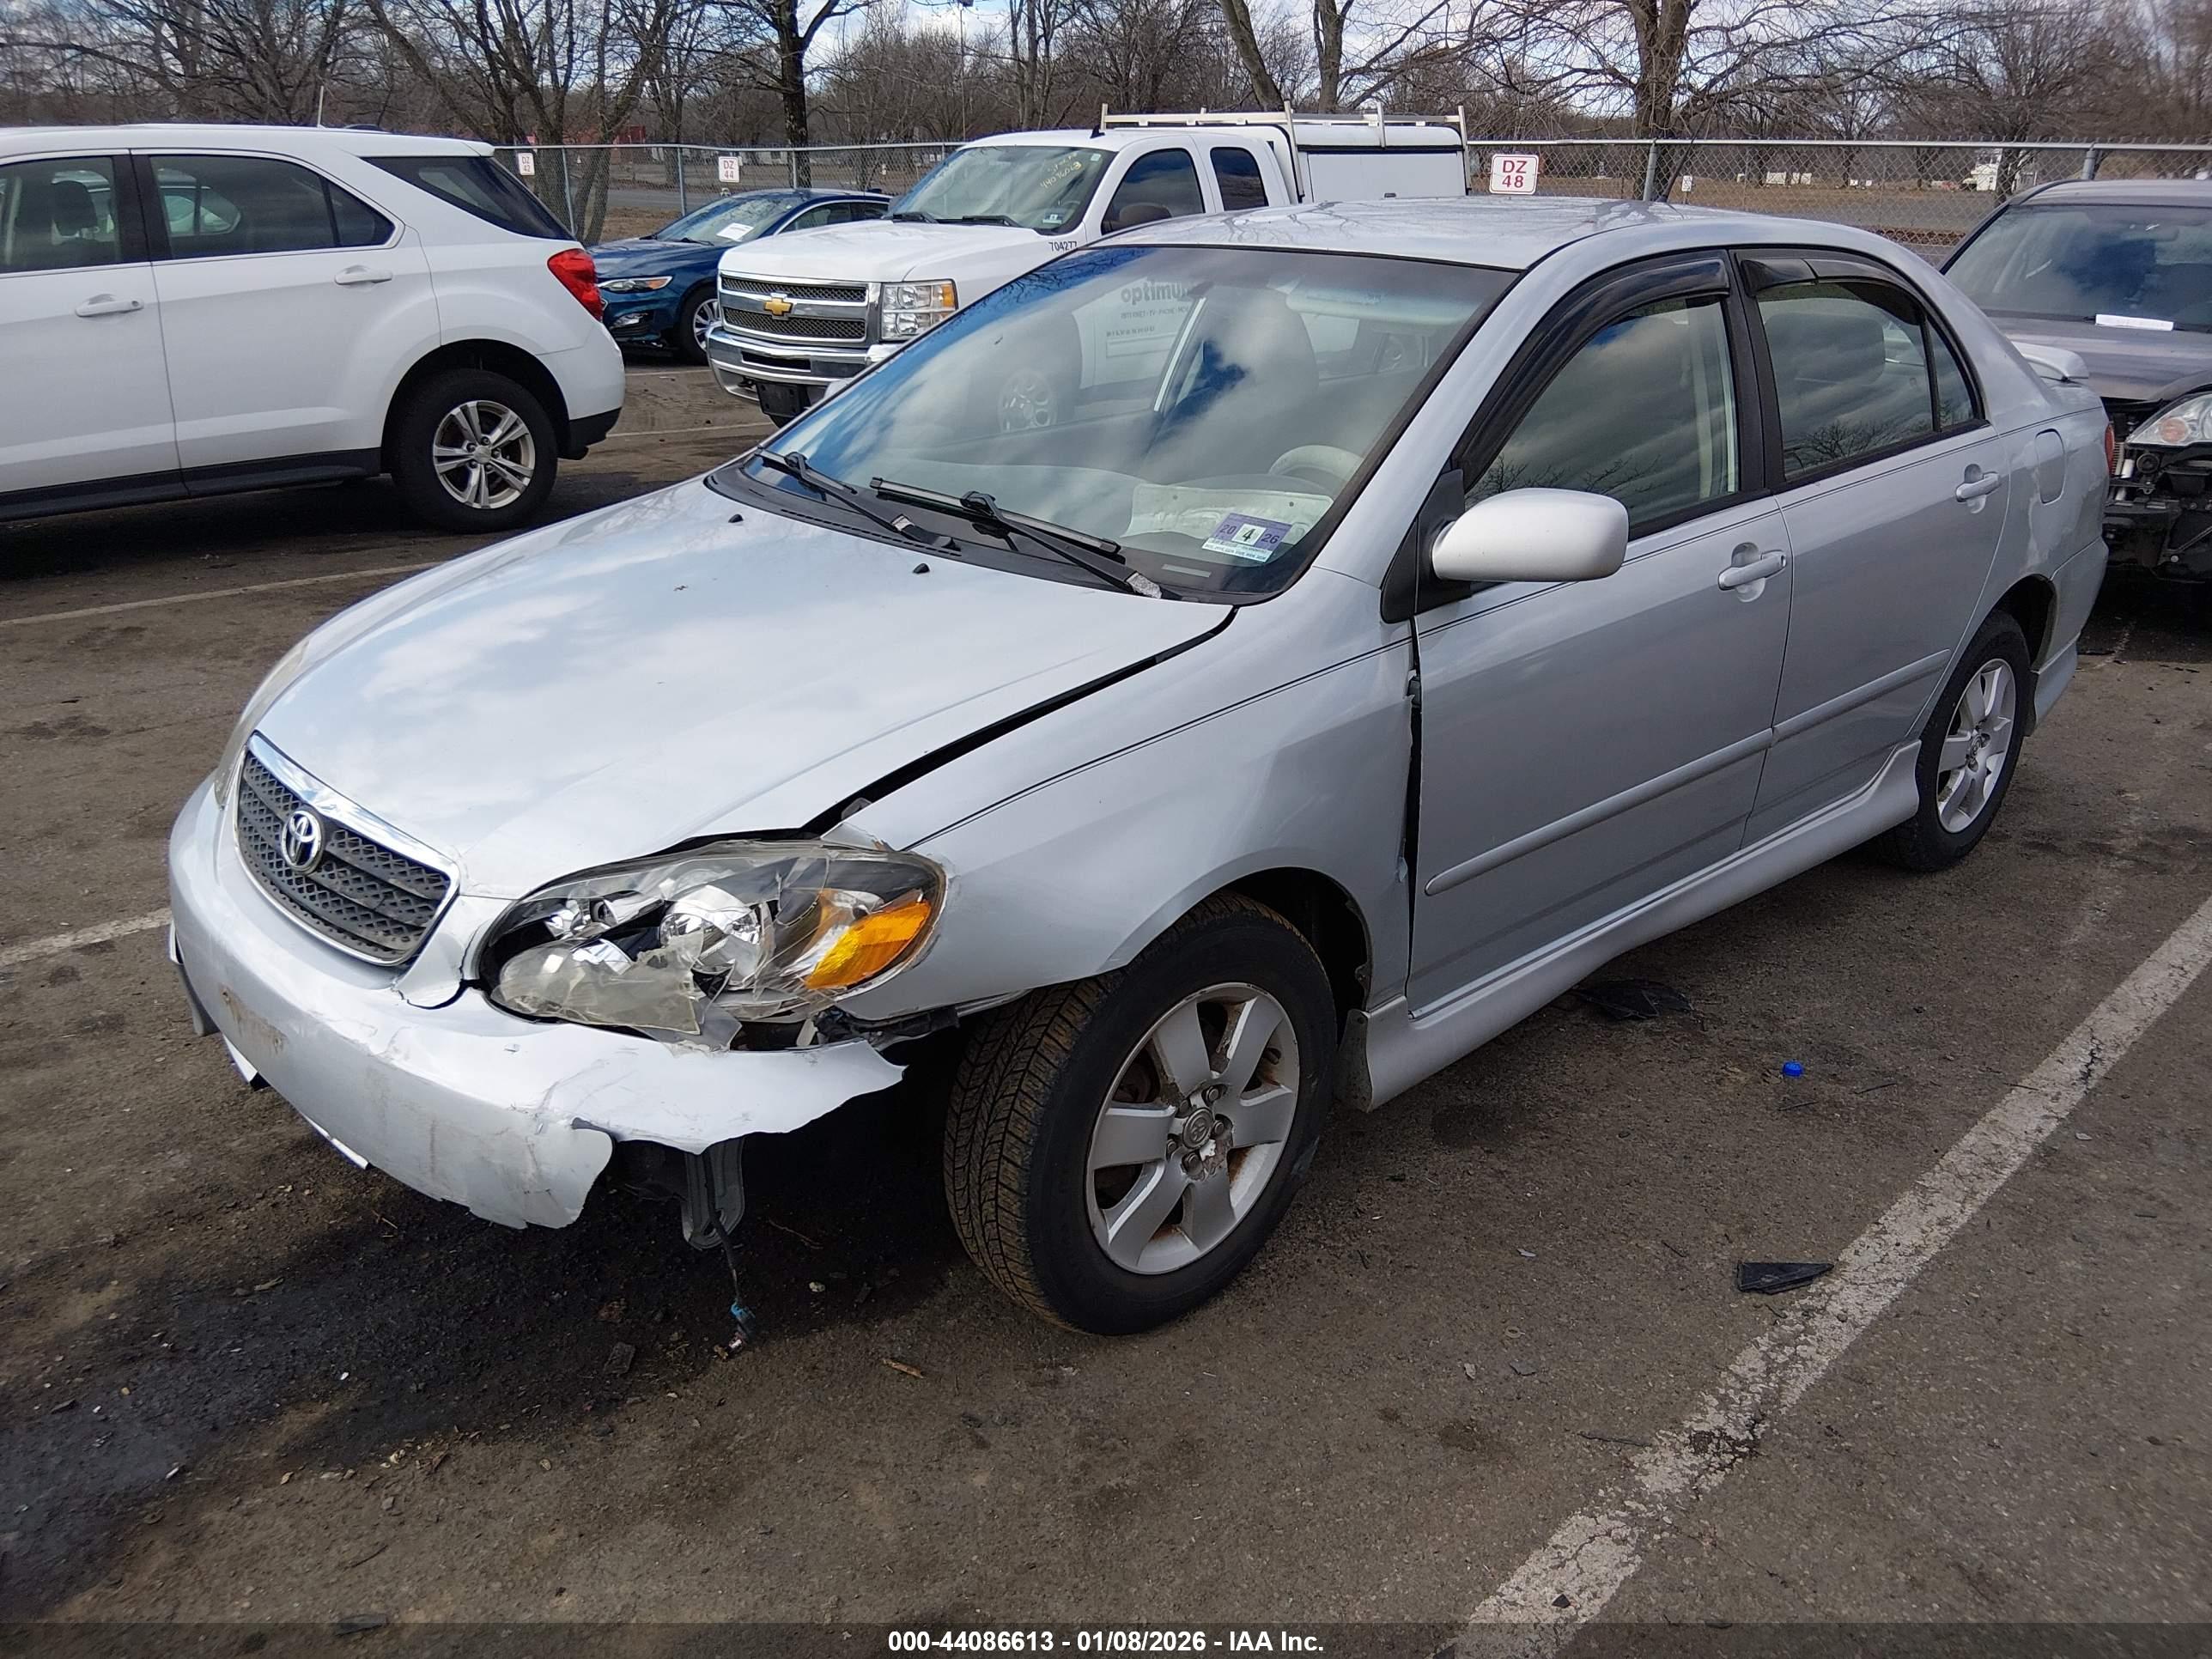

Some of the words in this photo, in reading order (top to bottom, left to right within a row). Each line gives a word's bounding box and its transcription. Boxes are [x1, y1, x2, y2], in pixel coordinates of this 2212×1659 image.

[724, 160, 735, 169] DZ
[1503, 160, 1528, 173] DZ
[725, 170, 734, 179] 44
[1502, 176, 1524, 188] 48
[1048, 241, 1078, 252] 704277
[1219, 525, 1237, 536] 20
[1241, 529, 1256, 543] 4
[1261, 533, 1280, 544] 26
